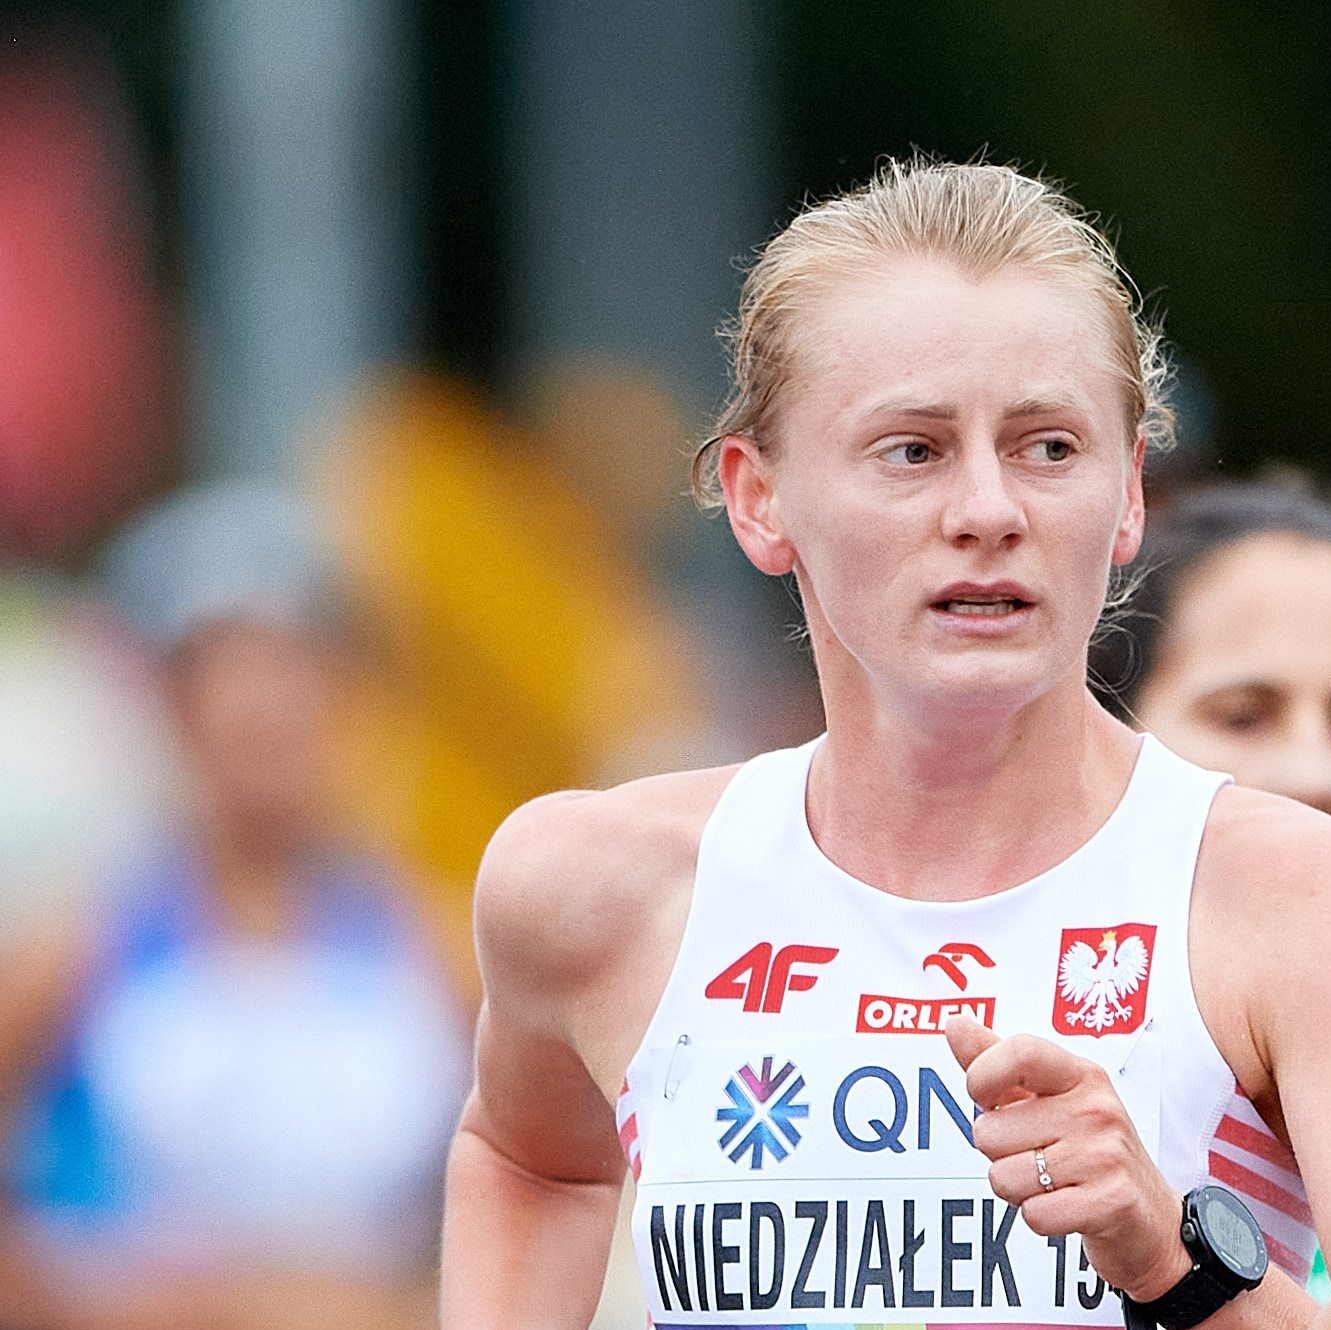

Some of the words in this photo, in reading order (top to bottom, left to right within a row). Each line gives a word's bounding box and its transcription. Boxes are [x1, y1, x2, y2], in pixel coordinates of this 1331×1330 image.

[705, 942, 839, 1013] 4F
[864, 1000, 987, 1031] ORLEN
[832, 1066, 984, 1153] QN
[649, 1198, 1022, 1311] NIEDZIAŁEK
[1047, 1235, 1122, 1310] 15
